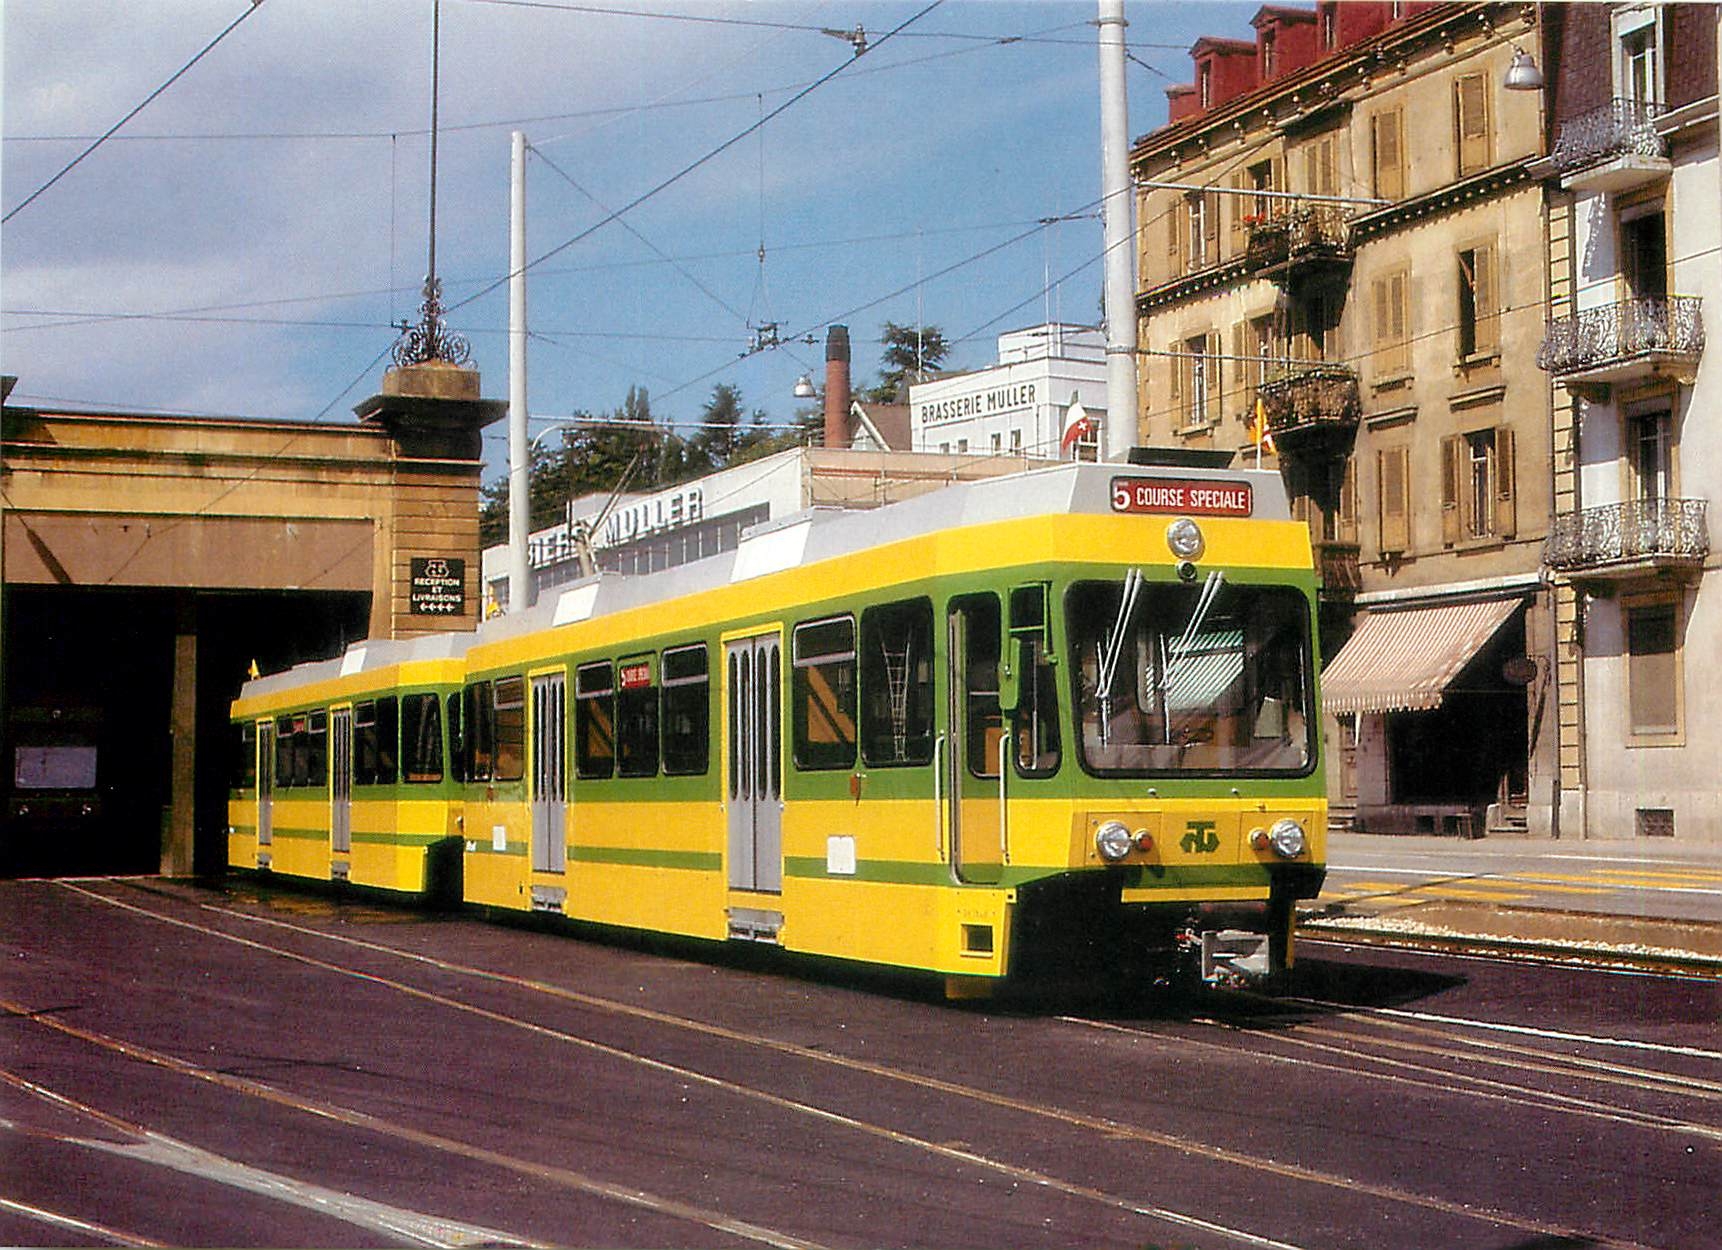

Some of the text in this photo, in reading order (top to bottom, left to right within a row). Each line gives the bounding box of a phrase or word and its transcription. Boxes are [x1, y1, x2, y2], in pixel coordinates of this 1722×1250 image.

[921, 384, 1036, 423] BRASSERIE MULLER
[1113, 482, 1246, 510] 5 COURSE SPECIALE
[604, 488, 704, 548] MULLER
